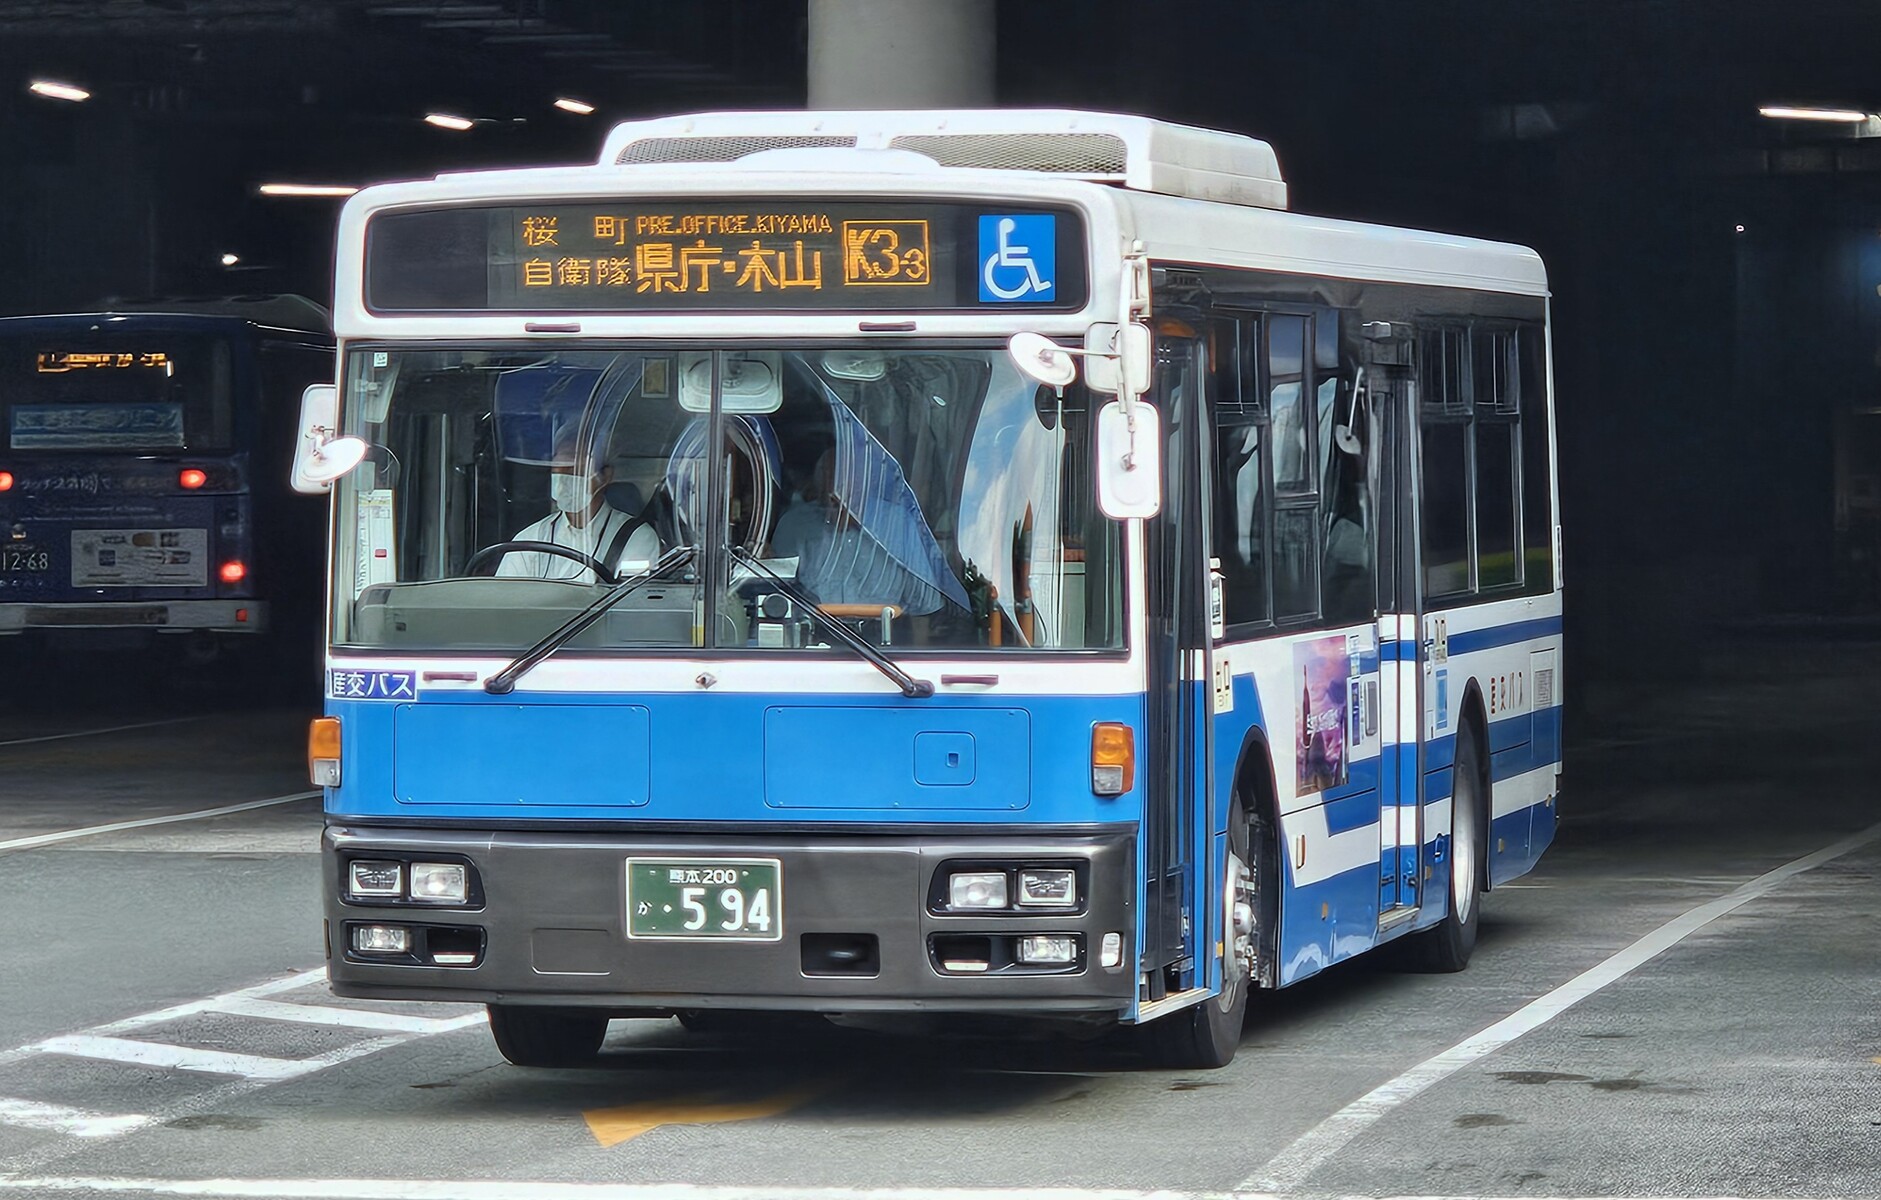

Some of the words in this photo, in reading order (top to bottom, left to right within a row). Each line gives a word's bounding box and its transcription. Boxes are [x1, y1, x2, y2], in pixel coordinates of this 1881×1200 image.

[524, 257, 631, 286] 自衛隊
[636, 239, 822, 294] 県庁・木山
